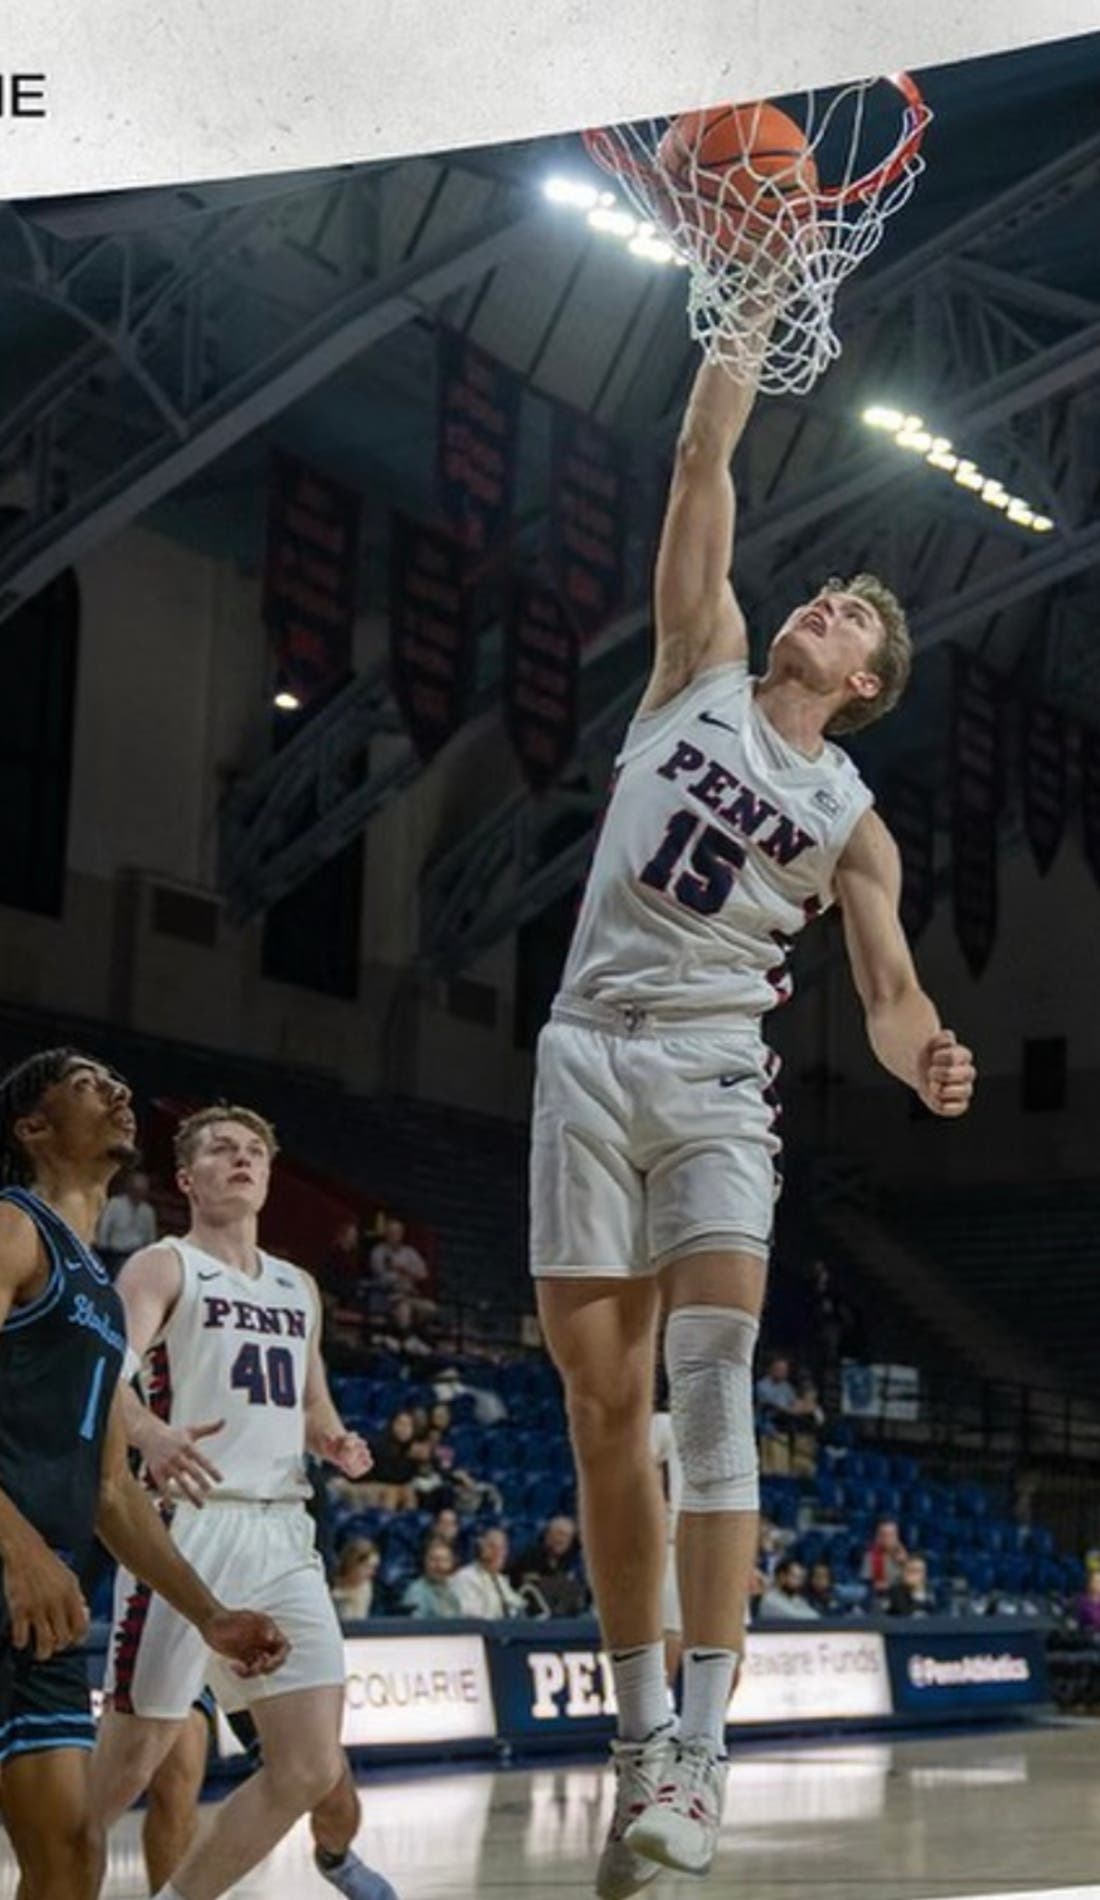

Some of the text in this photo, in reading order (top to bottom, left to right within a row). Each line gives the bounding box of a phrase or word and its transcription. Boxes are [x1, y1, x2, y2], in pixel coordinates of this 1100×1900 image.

[656, 740, 816, 867] PENN
[638, 809, 748, 915] 15
[203, 1297, 306, 1339] PENN
[79, 1356, 106, 1440] 1
[230, 1342, 297, 1409] 40
[345, 1669, 478, 1709] CQUARIE
[817, 1641, 881, 1674] Funds
